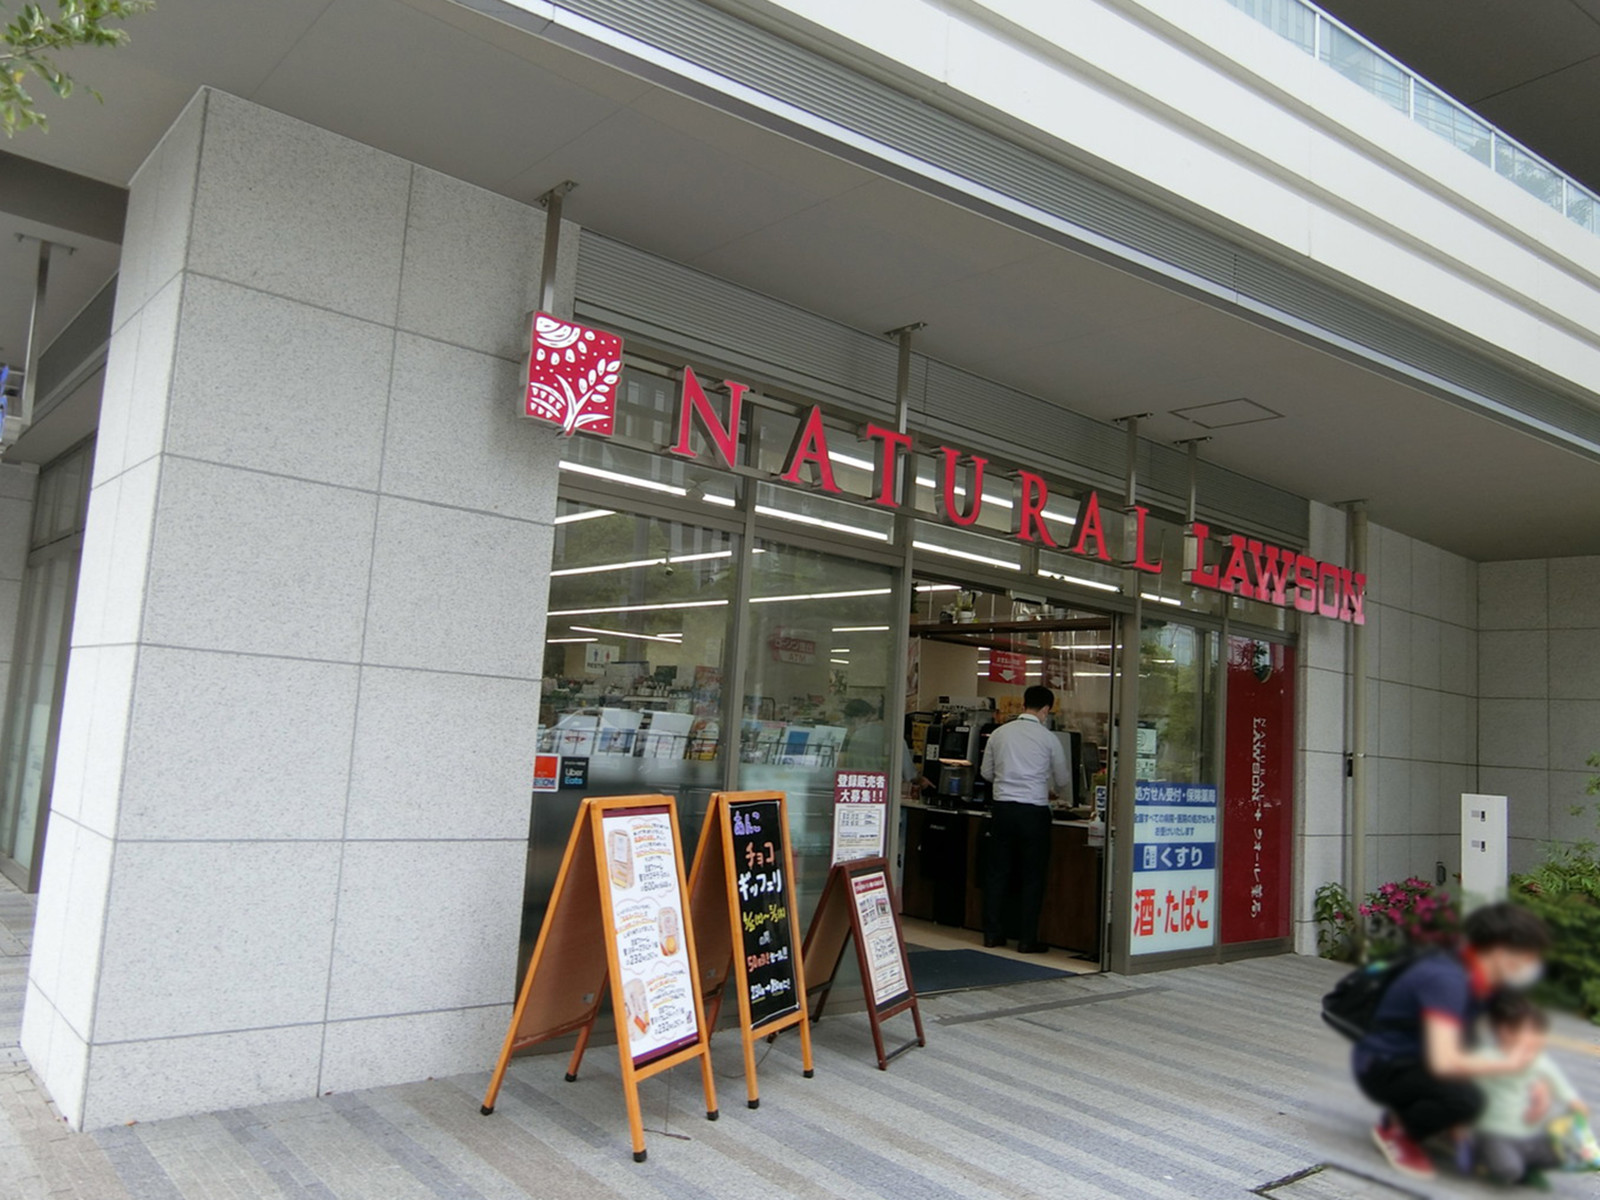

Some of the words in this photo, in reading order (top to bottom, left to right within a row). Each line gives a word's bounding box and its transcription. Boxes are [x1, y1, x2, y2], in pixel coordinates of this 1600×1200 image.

[669, 364, 1163, 574] NATURAL
[1190, 522, 1367, 626] LAWSON
[565, 768, 583, 776] Uber
[837, 774, 886, 788] 登録販売者
[745, 841, 775, 870] チョコ
[1161, 846, 1203, 868] くすり
[738, 869, 782, 901] ギッフェリ
[1133, 885, 1209, 937] 酒・たばこ
